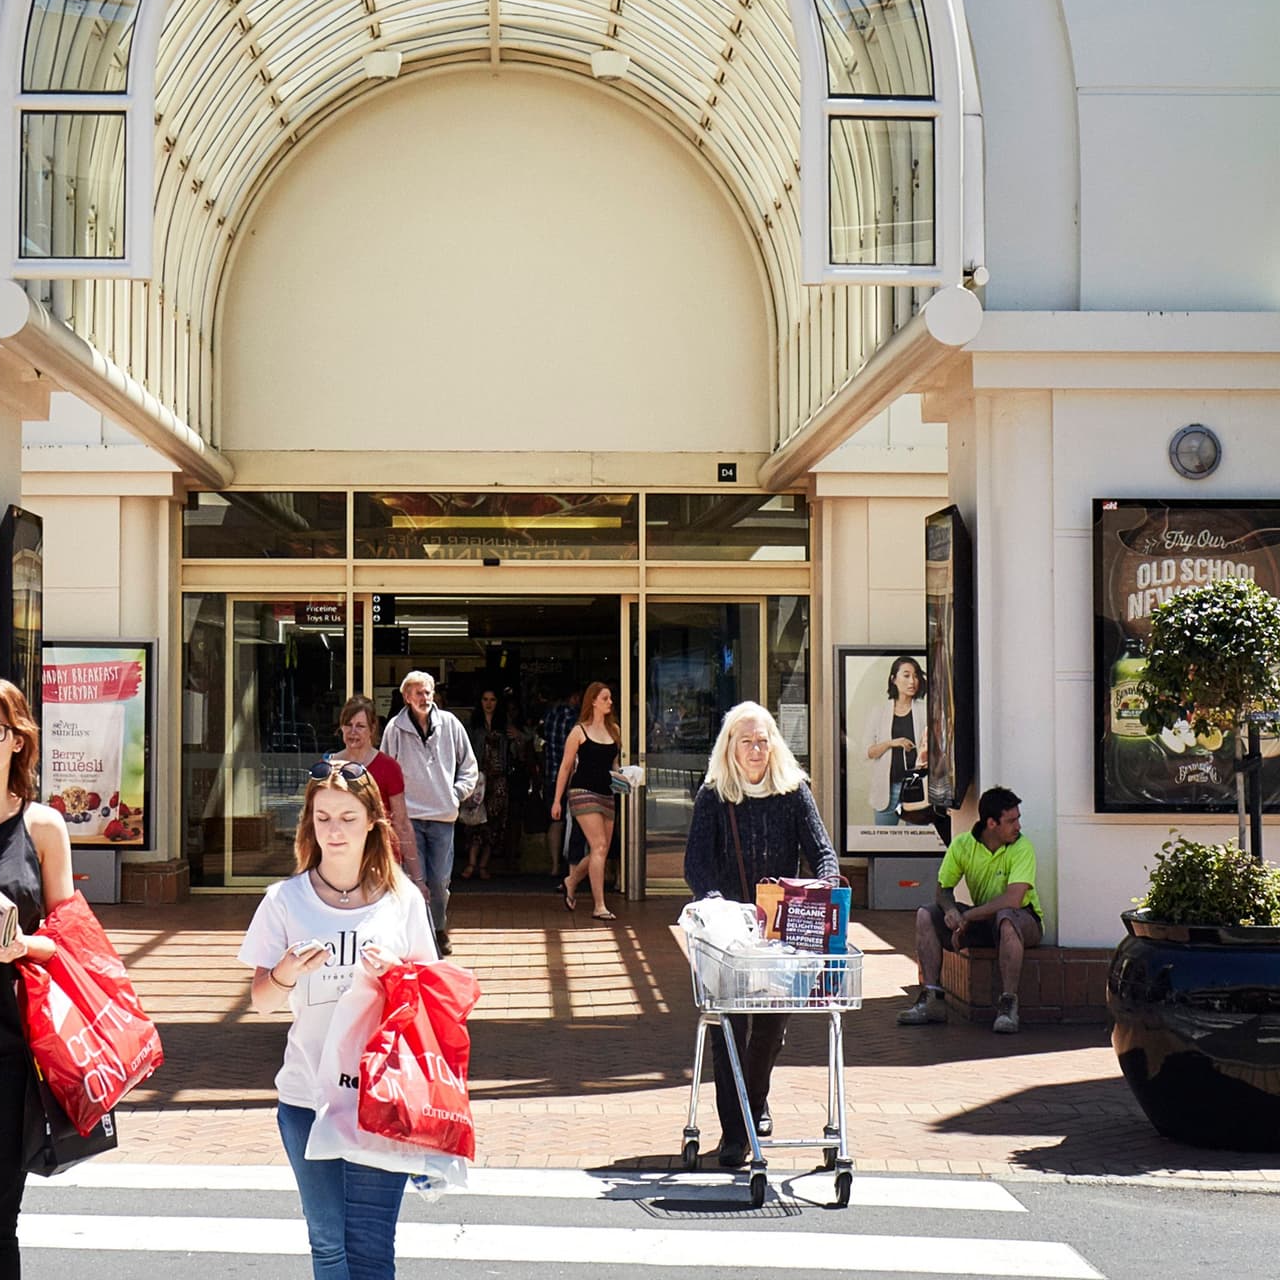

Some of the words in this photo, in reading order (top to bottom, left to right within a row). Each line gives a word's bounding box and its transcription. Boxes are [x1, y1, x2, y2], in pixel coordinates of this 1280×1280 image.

[721, 468, 734, 477] D4
[1164, 530, 1194, 552] Try
[1197, 529, 1228, 550] Our
[1136, 558, 1176, 589] OLD
[306, 605, 337, 613] Priceline
[306, 615, 323, 623] Toys
[71, 666, 120, 684] BREAKFAST
[58, 685, 99, 701] EVERYDAY
[52, 749, 85, 762] Berry
[52, 759, 105, 772] muesli
[787, 907, 826, 918] ORGANIC
